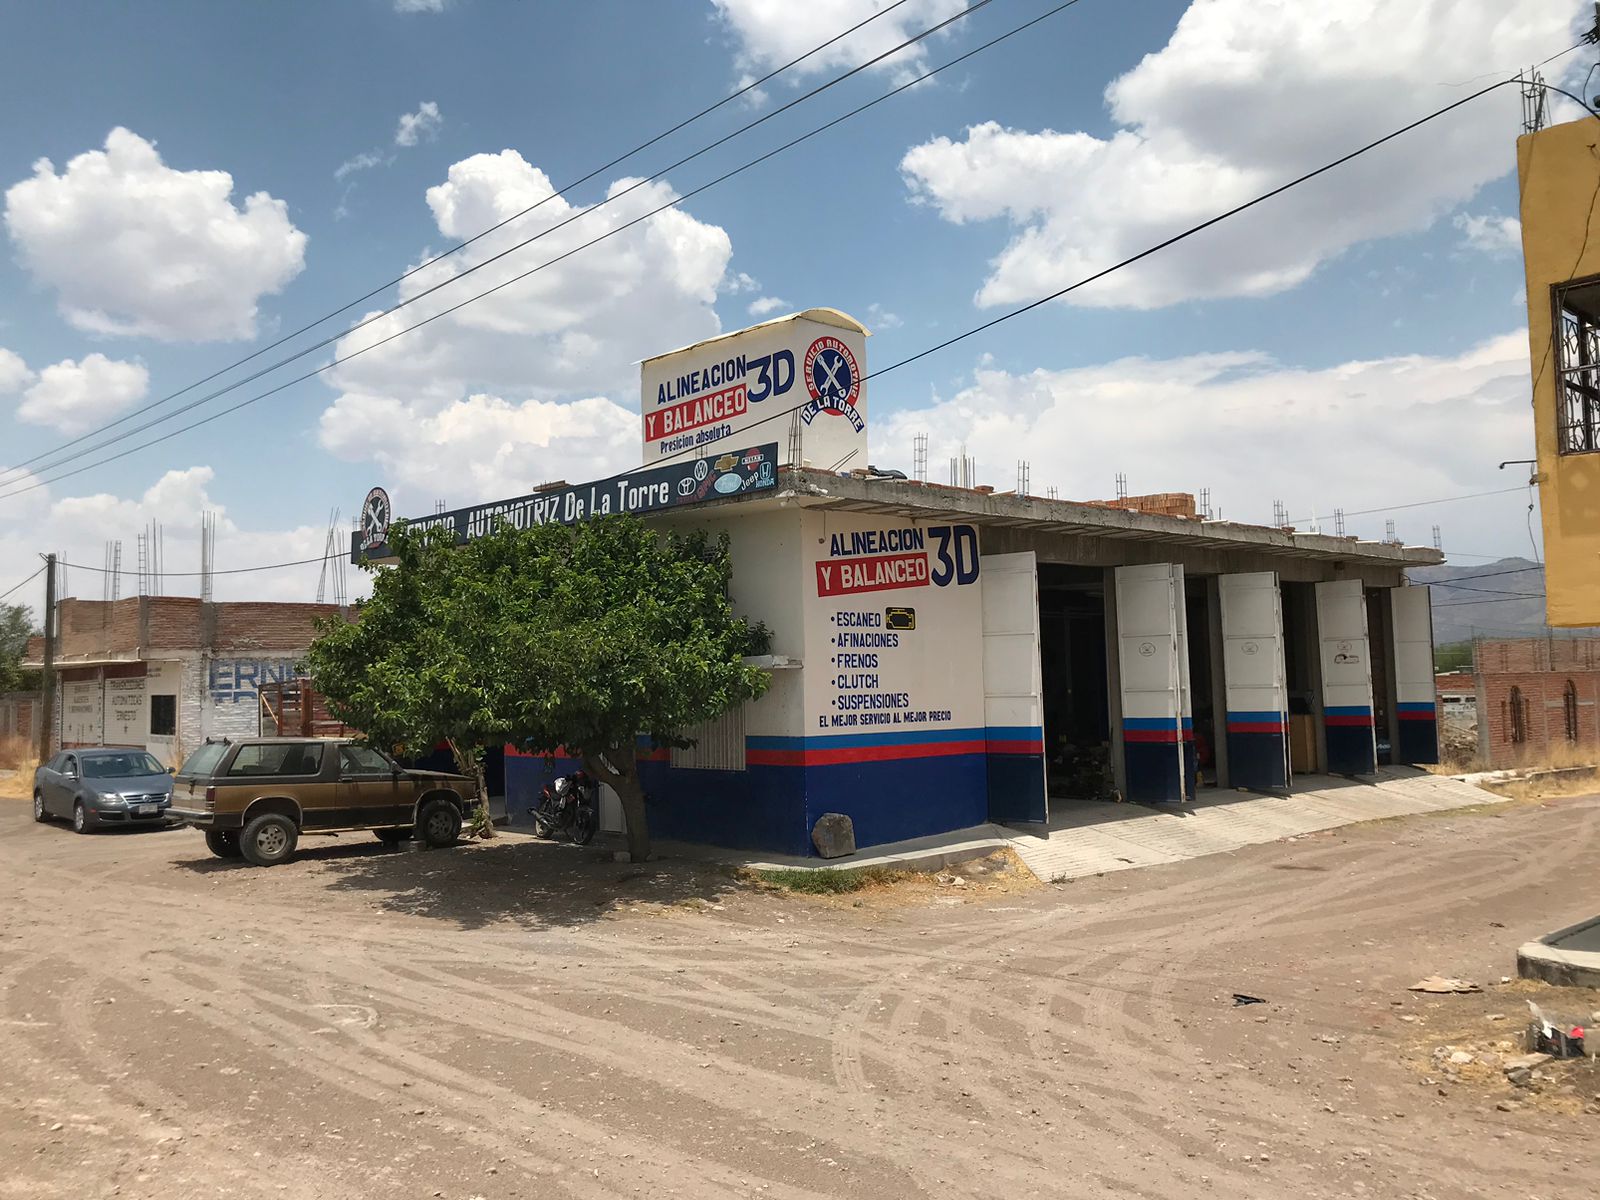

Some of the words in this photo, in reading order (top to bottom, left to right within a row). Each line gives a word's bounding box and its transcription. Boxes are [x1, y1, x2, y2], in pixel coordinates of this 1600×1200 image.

[658, 354, 746, 405] ALINEACION
[746, 349, 796, 403] 3D
[805, 341, 824, 391] SERVICIO
[647, 415, 657, 438] Y
[663, 387, 745, 434] BALANCEO
[802, 402, 817, 423] DE
[817, 396, 831, 409] LA
[832, 396, 865, 431] TORRE
[660, 434, 694, 454] Presicion
[695, 423, 732, 444] absoluta
[741, 472, 759, 490] Jeep
[564, 492, 584, 521] De
[590, 487, 611, 516] La
[618, 480, 669, 512] Torre
[830, 528, 924, 556] ALINEACION
[928, 525, 980, 587] 3D
[820, 567, 832, 590] Y
[841, 558, 927, 589] BALANCEO
[836, 611, 880, 627] ESCANEO
[837, 633, 899, 648] AFINACIONES
[837, 654, 878, 668] FRENOS
[837, 674, 879, 689] CLUTCH
[837, 693, 909, 710] SUSPENSIONES
[820, 716, 829, 727] EL
[832, 714, 858, 727] MEJOR
[860, 712, 891, 725] SERVICIO
[893, 712, 902, 724] AL
[904, 711, 927, 723] MEJOR
[929, 710, 952, 721] PRECIO
